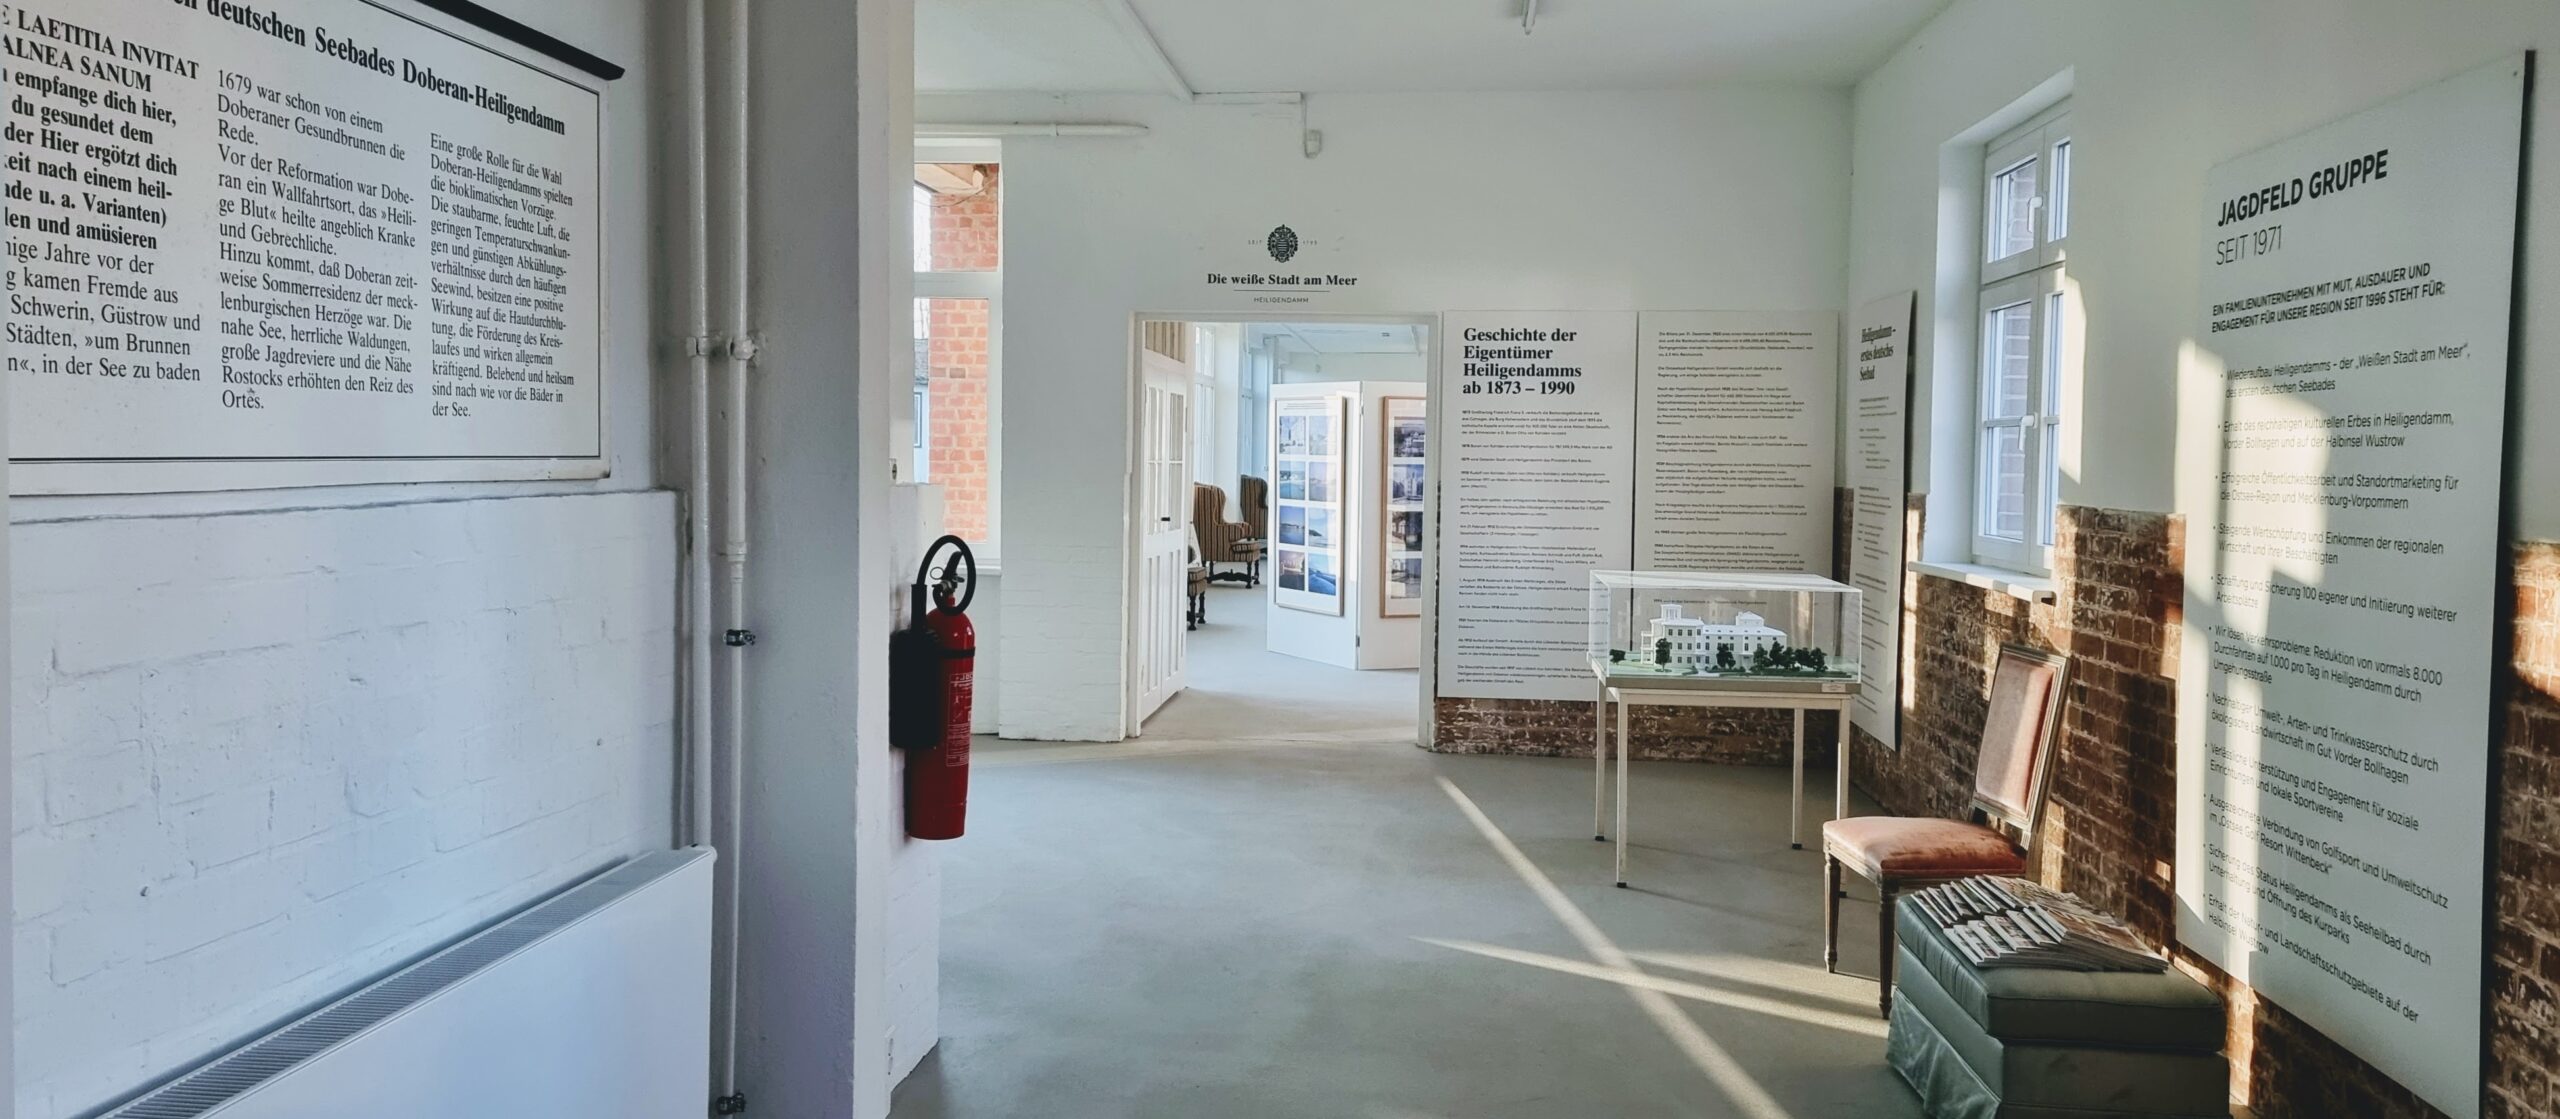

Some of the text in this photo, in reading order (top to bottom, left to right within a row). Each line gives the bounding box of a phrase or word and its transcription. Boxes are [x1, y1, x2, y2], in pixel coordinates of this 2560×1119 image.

[18, 9, 199, 79] LAETITIA INVITAT
[81, 56, 151, 92] SANUM
[207, 0, 565, 136] deutschen Seebades Doberan-Heiligendamm
[12, 94, 153, 144] du gesundet dem
[15, 72, 176, 128] empfange dich hier,
[219, 70, 383, 133] 1679 war schon von einem
[218, 94, 405, 160] Doberaner Gesundbrunnen die
[4, 121, 177, 176] der Hier ergötzt dich
[431, 133, 453, 153] Eine
[456, 145, 483, 162] große
[487, 150, 509, 169] Rolle
[527, 163, 539, 178] die
[542, 167, 562, 185] Wahl
[431, 154, 572, 206] Doberan-Heiligendamms spielten
[431, 175, 445, 192] die
[449, 179, 518, 210] bioklimatischen
[2218, 149, 2389, 227] JAGDFELD GRUPPE
[219, 199, 234, 216] ge
[282, 206, 315, 229] heilte
[321, 220, 373, 240] angeblich
[378, 226, 415, 247] Kranke
[431, 195, 448, 213] Die
[452, 204, 501, 227] staubarme,
[558, 227, 570, 241] die
[220, 223, 336, 255] und Gebrechliche.
[2216, 225, 2282, 266] SEIT 1971
[1207, 273, 1358, 286] Die weiße Stadt am Meer
[2213, 263, 2431, 316] EIN FAMILIENUNTERNEHMEN MIT MUT, AUSDAUER UND
[11, 294, 200, 331] Schwerin, Güstrow und
[221, 291, 411, 330] lenburgischen Herzöge war. Die
[2212, 279, 2446, 333] ENGAGEMENT FÜR UNSERE REGION SEIT 1996 STEHT FÜR:
[6, 322, 77, 349] Städten,
[126, 333, 190, 355] Brunnen
[1464, 327, 1577, 341] Geschichte der
[43, 354, 58, 373] in
[66, 356, 92, 375] der
[100, 358, 126, 377] See
[133, 365, 150, 378] zu
[156, 361, 200, 381] baden
[433, 360, 574, 385] kräftigend. Belebend und heilsam
[1463, 363, 1582, 380] Heiligendamms
[1464, 345, 1553, 362] Eigentümer
[2274, 361, 2331, 378] Heiligendamms
[2339, 356, 2354, 370] der
[2393, 349, 2419, 365] Stadt
[2420, 349, 2436, 362] am
[1462, 381, 1482, 394] ab
[1487, 381, 1522, 394] 1873
[1540, 381, 1575, 395] 1990
[2261, 377, 2336, 395] deutschen Seebades
[2347, 412, 2372, 428] Erbes
[2373, 413, 2382, 427] in
[2384, 411, 2454, 429] Heiligendamm,
[2326, 434, 2405, 448] Halbinsel Wustrow
[2338, 474, 2460, 493] und Standortmarketing für
[2326, 532, 2444, 555] Einkommen der regionalen
[2302, 586, 2317, 600] 100
[2318, 590, 2349, 606] eigener
[2350, 594, 2367, 608] und
[2369, 597, 2415, 619] Initiierung
[2417, 604, 2458, 622] weiterer
[2257, 652, 2269, 664] auf
[2270, 654, 2290, 670] 1.000
[2291, 661, 2305, 674] pro
[2306, 662, 2320, 680] Tag
[2321, 668, 2329, 680] in
[2331, 669, 2392, 696] Heiligendamm
[2394, 685, 2422, 703] durch
[2262, 816, 2449, 909] Verbindung von Golfsport und Umweltschutz
[2280, 933, 2419, 1024] Landschaftsschutzgebiete auf der
